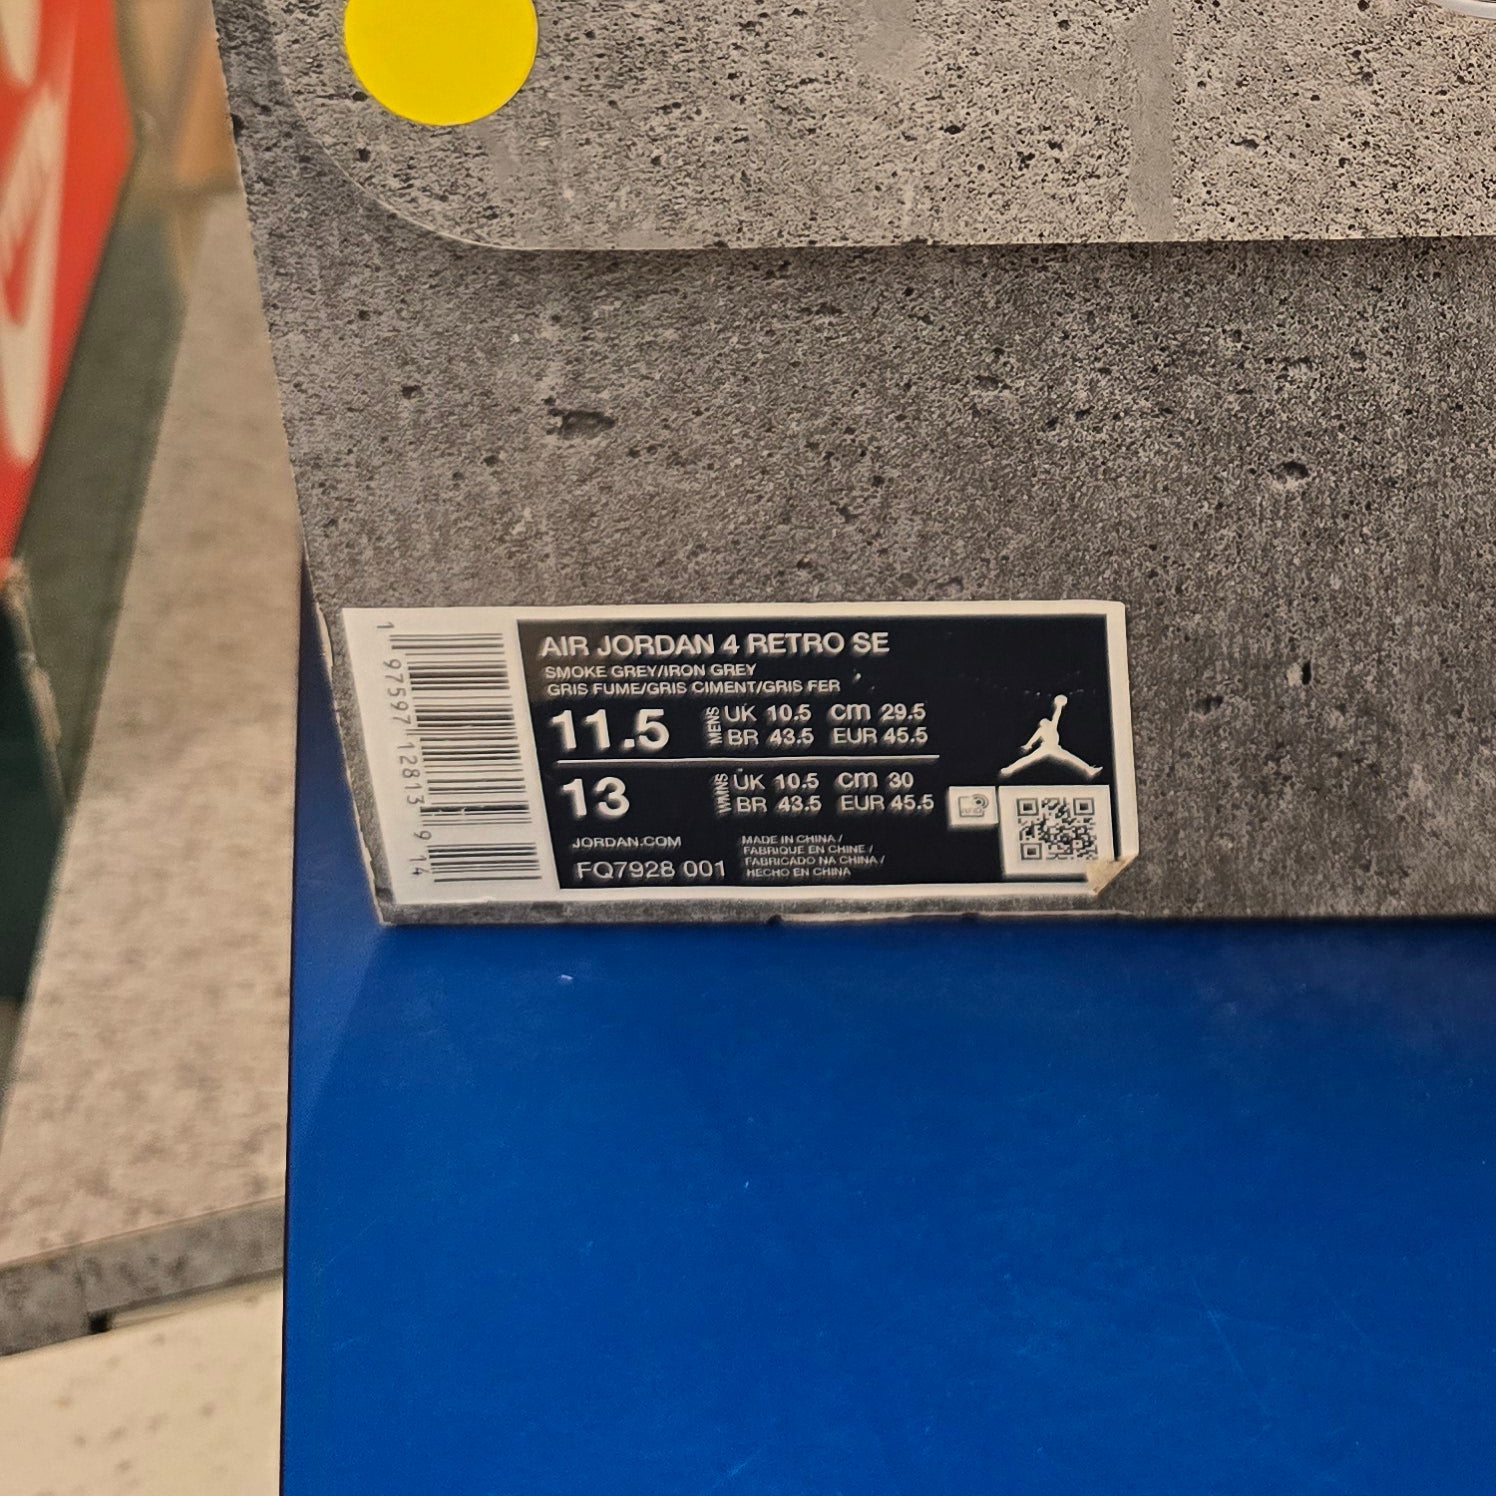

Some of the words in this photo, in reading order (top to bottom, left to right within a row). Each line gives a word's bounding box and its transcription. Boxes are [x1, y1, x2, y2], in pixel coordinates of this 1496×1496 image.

[541, 635, 589, 656] AIR
[597, 634, 714, 655] JORDAN
[721, 634, 740, 654] 4
[747, 632, 845, 654] RETRO
[853, 632, 890, 653] SE
[545, 665, 607, 678] SMOKE
[611, 664, 706, 677] GREY/IRON
[710, 663, 757, 676] GREY
[547, 683, 588, 696] GRIS
[593, 682, 687, 695] FUME/GRIS
[692, 680, 803, 694] CIMENT/GRIS
[808, 679, 841, 692] FER
[724, 705, 757, 722] UK
[766, 704, 812, 721] 10.5
[830, 703, 871, 720] cm
[880, 703, 926, 720] 29.5
[551, 708, 670, 750] 11.5
[705, 706, 723, 745] MENS
[727, 729, 759, 745] BR
[769, 728, 814, 744] 43.5
[832, 727, 877, 744] EUR
[883, 726, 928, 743] 45.5
[383, 659, 411, 724] 97597
[397, 742, 425, 804] 12813
[413, 830, 432, 840] 9
[733, 774, 765, 790] UK
[774, 773, 819, 789] 10.5
[838, 772, 878, 788] cm
[888, 772, 914, 788] 30
[562, 776, 630, 817] 13
[714, 773, 732, 814] WMNS
[736, 797, 767, 812] BR
[778, 795, 822, 812] 43.5
[840, 795, 885, 811] EUR
[890, 794, 934, 810] 45.5
[572, 836, 681, 848] JORDAN.COM
[741, 835, 777, 844] MADE
[781, 835, 793, 843] IN
[796, 834, 834, 843] CHINA
[743, 846, 805, 855] FABRIQUE
[808, 845, 824, 854] EN
[828, 845, 865, 853] CHINE
[577, 861, 675, 879] FQ7928
[684, 860, 725, 877] 001
[745, 856, 815, 866] FABRICADO
[819, 856, 836, 865] NA
[840, 855, 877, 864] CHINA
[746, 868, 789, 877] HECHO
[793, 868, 809, 876] EN
[813, 867, 851, 876] CHINA
